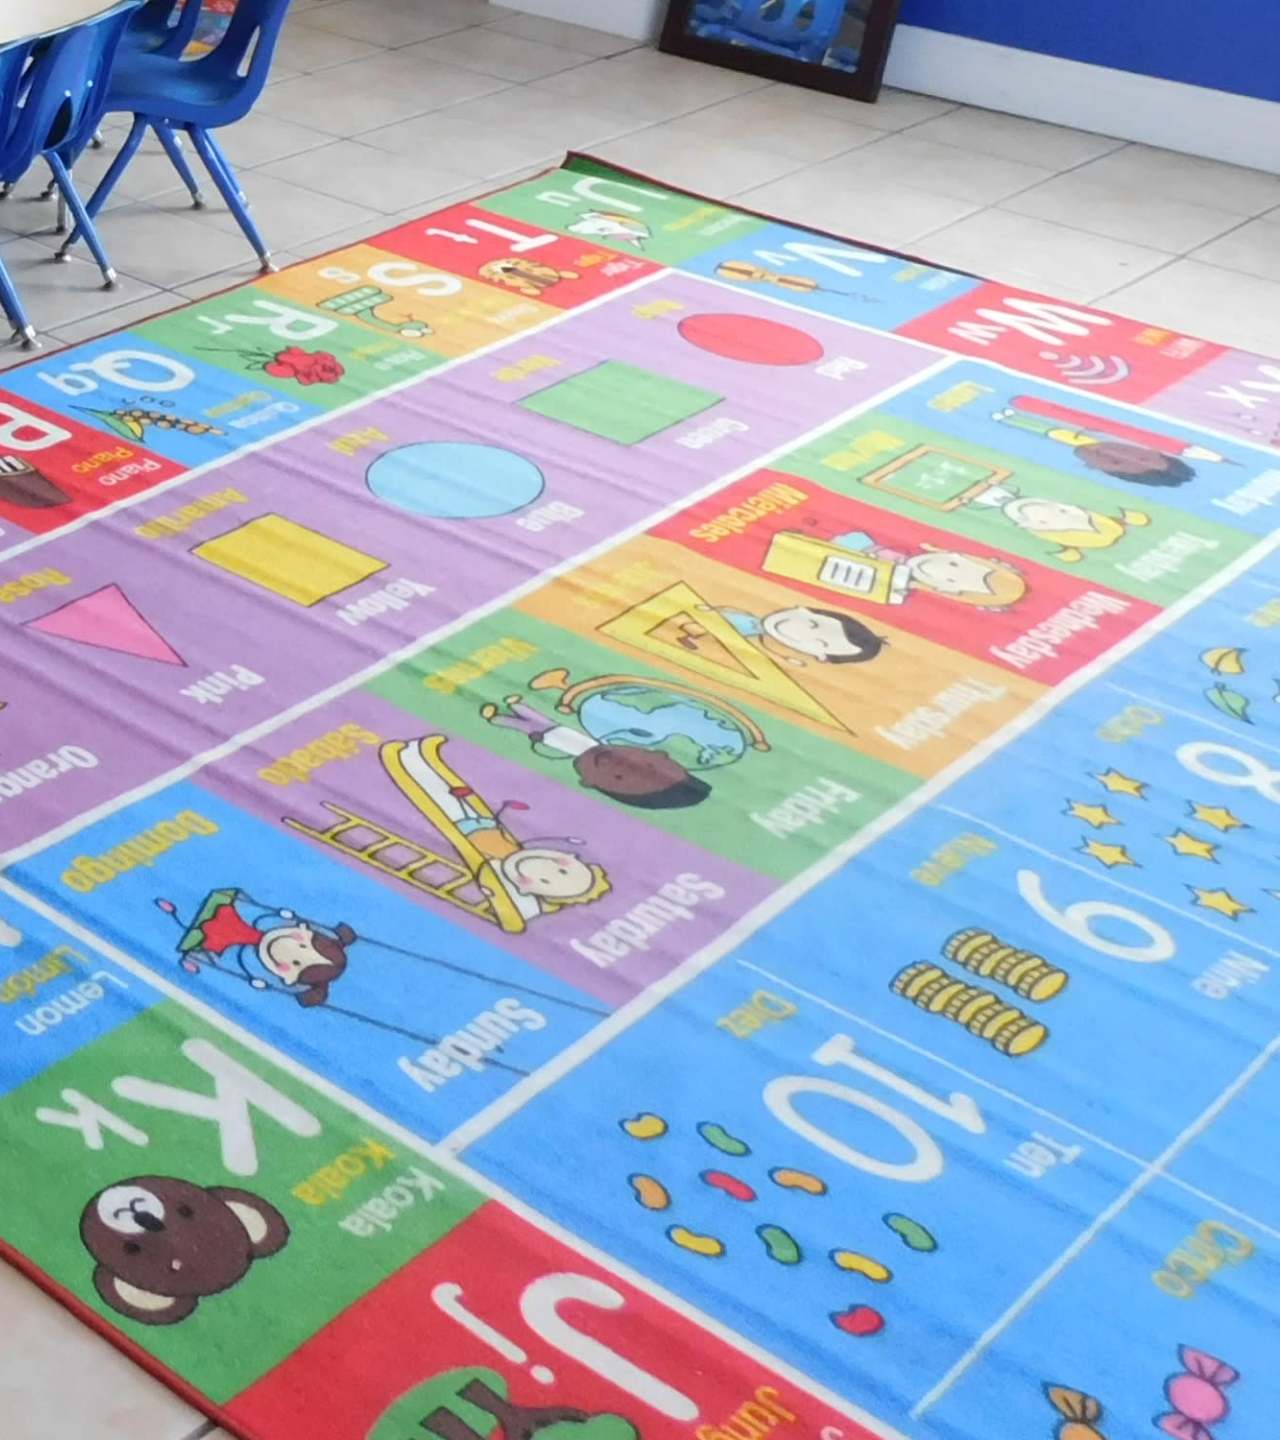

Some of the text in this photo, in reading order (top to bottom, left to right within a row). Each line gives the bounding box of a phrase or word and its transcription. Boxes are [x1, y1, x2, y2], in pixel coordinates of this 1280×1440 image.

[192, 299, 338, 342] Rr
[97, 457, 162, 488] Piano
[690, 482, 810, 544] Miércoles
[333, 576, 436, 627] Yellow
[987, 588, 1132, 671] Wednesday
[178, 663, 266, 708] Pink
[747, 774, 862, 843] Friday
[568, 871, 726, 970] Saturday
[1016, 867, 1178, 965] 9
[13, 968, 130, 1040] Lemon
[394, 996, 548, 1095] Sunday
[33, 1037, 324, 1178] Kk
[762, 1032, 985, 1185] 10
[290, 1136, 397, 1210] Koala
[1000, 1131, 1083, 1180] Ten
[337, 1164, 446, 1242] Koala
[431, 1271, 700, 1423] Jj
